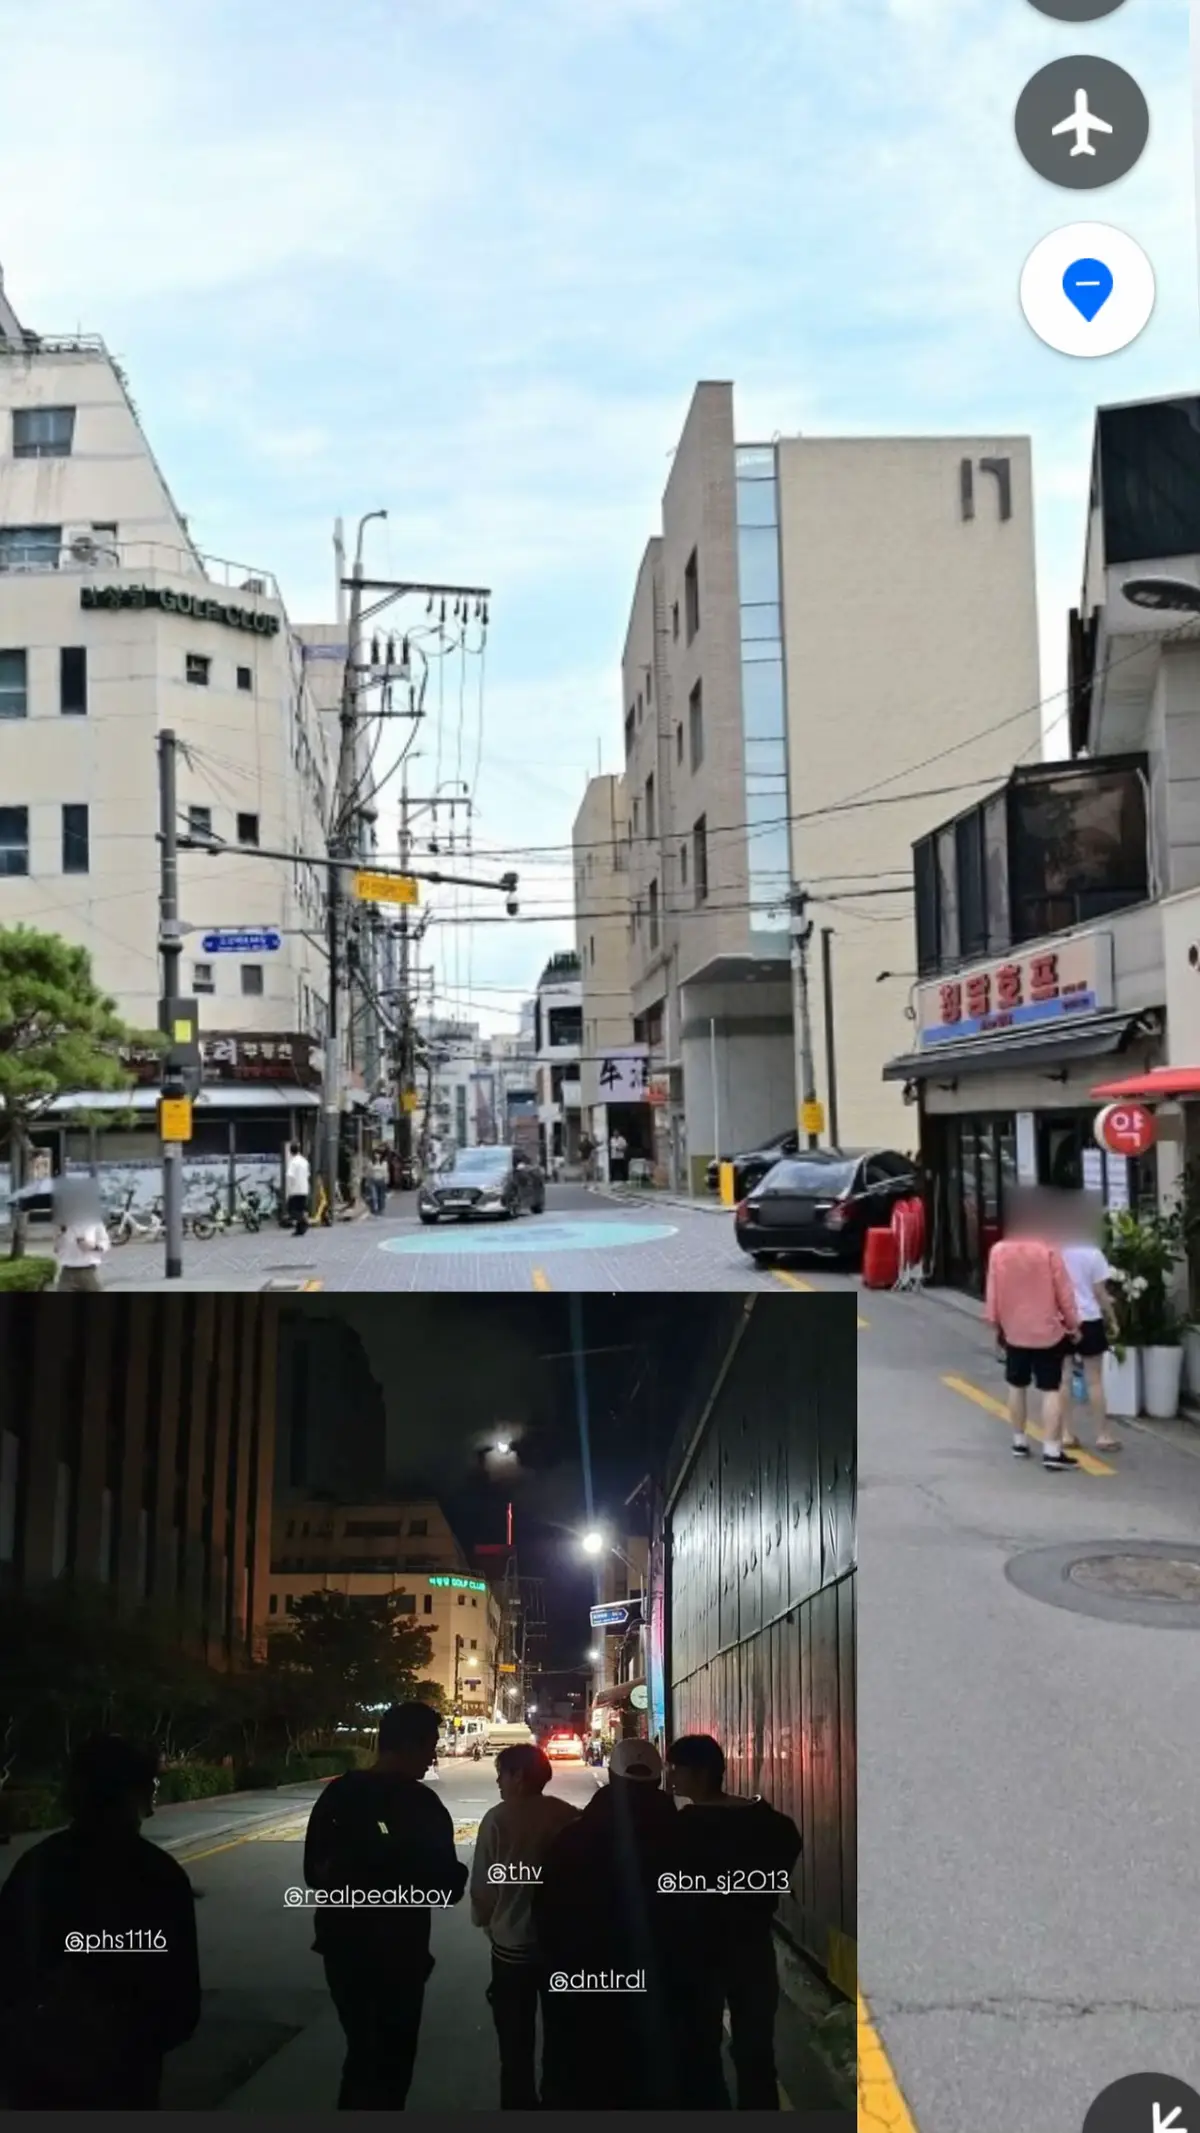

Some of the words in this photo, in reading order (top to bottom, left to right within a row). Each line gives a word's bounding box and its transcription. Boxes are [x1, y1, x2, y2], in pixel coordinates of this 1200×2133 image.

[160, 587, 219, 621] GOLF
[224, 603, 281, 637] CLUB
[1110, 1111, 1146, 1147] 약
